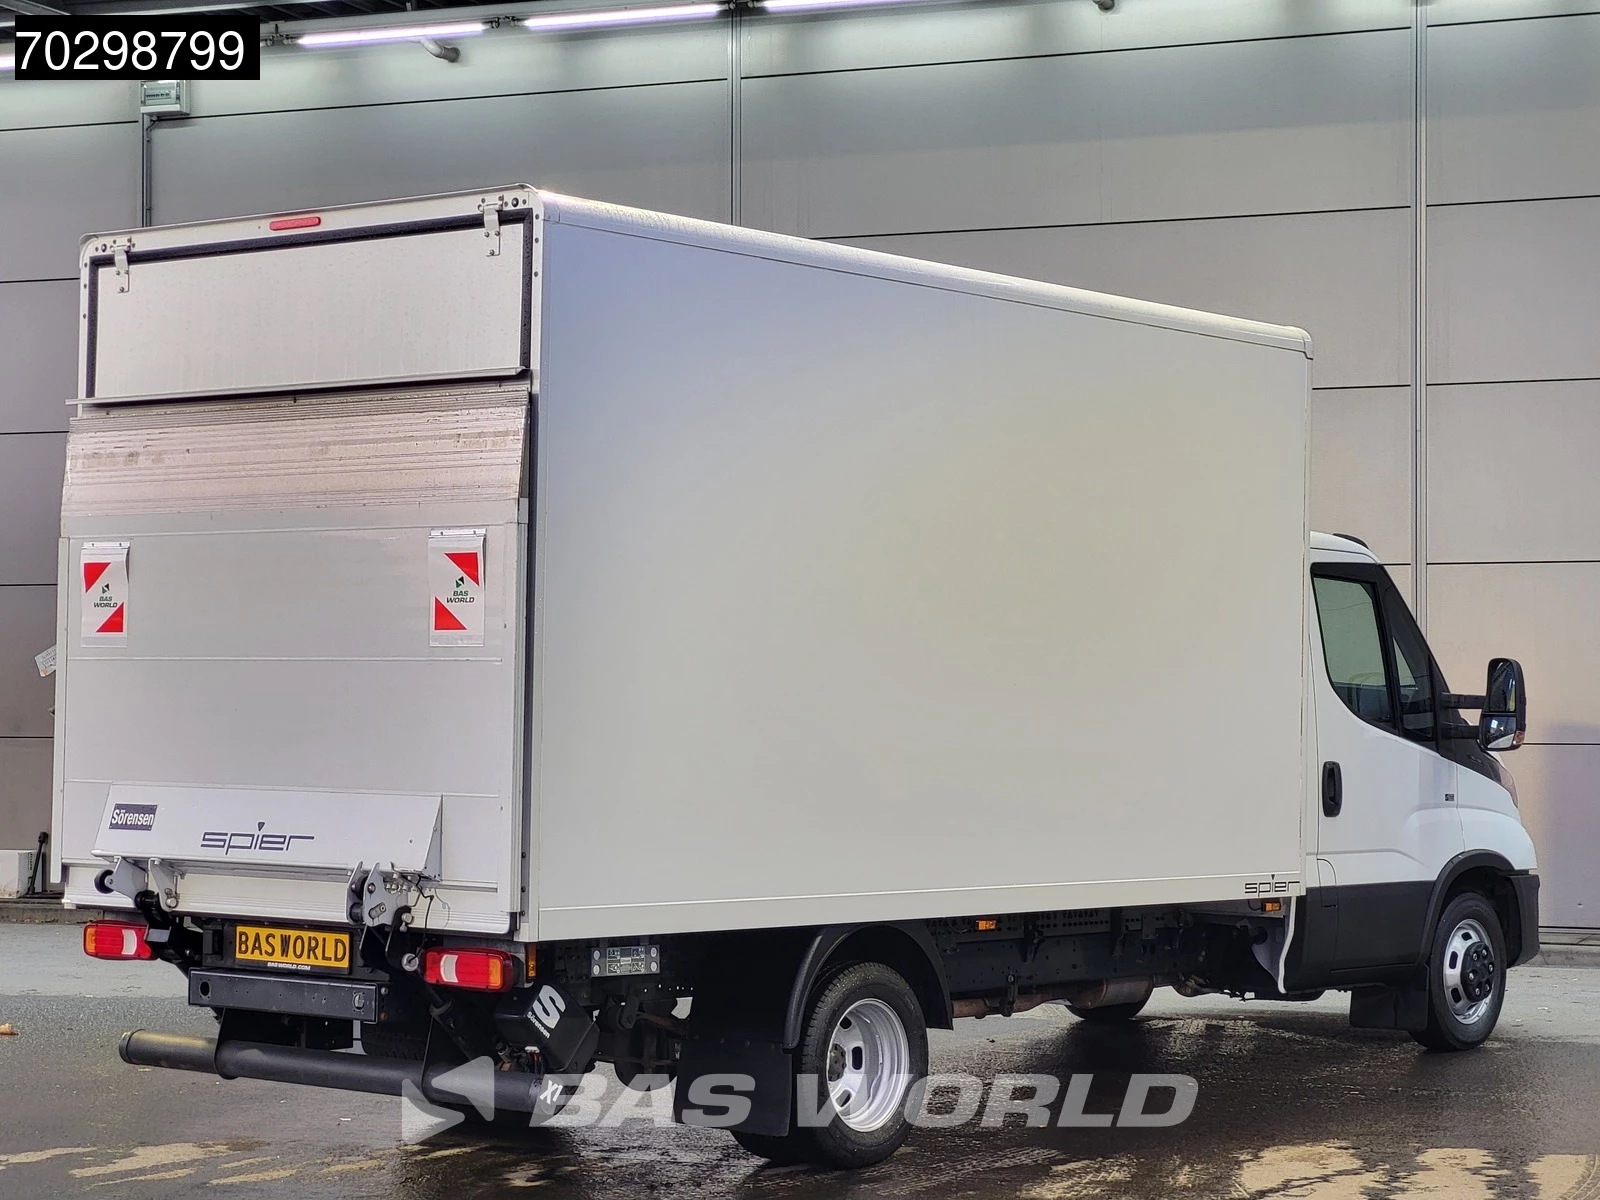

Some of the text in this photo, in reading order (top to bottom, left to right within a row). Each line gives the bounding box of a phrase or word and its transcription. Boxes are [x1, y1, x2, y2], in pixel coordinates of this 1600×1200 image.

[111, 809, 155, 826] Sörensen
[200, 822, 315, 855] spier
[1244, 874, 1300, 897] spier
